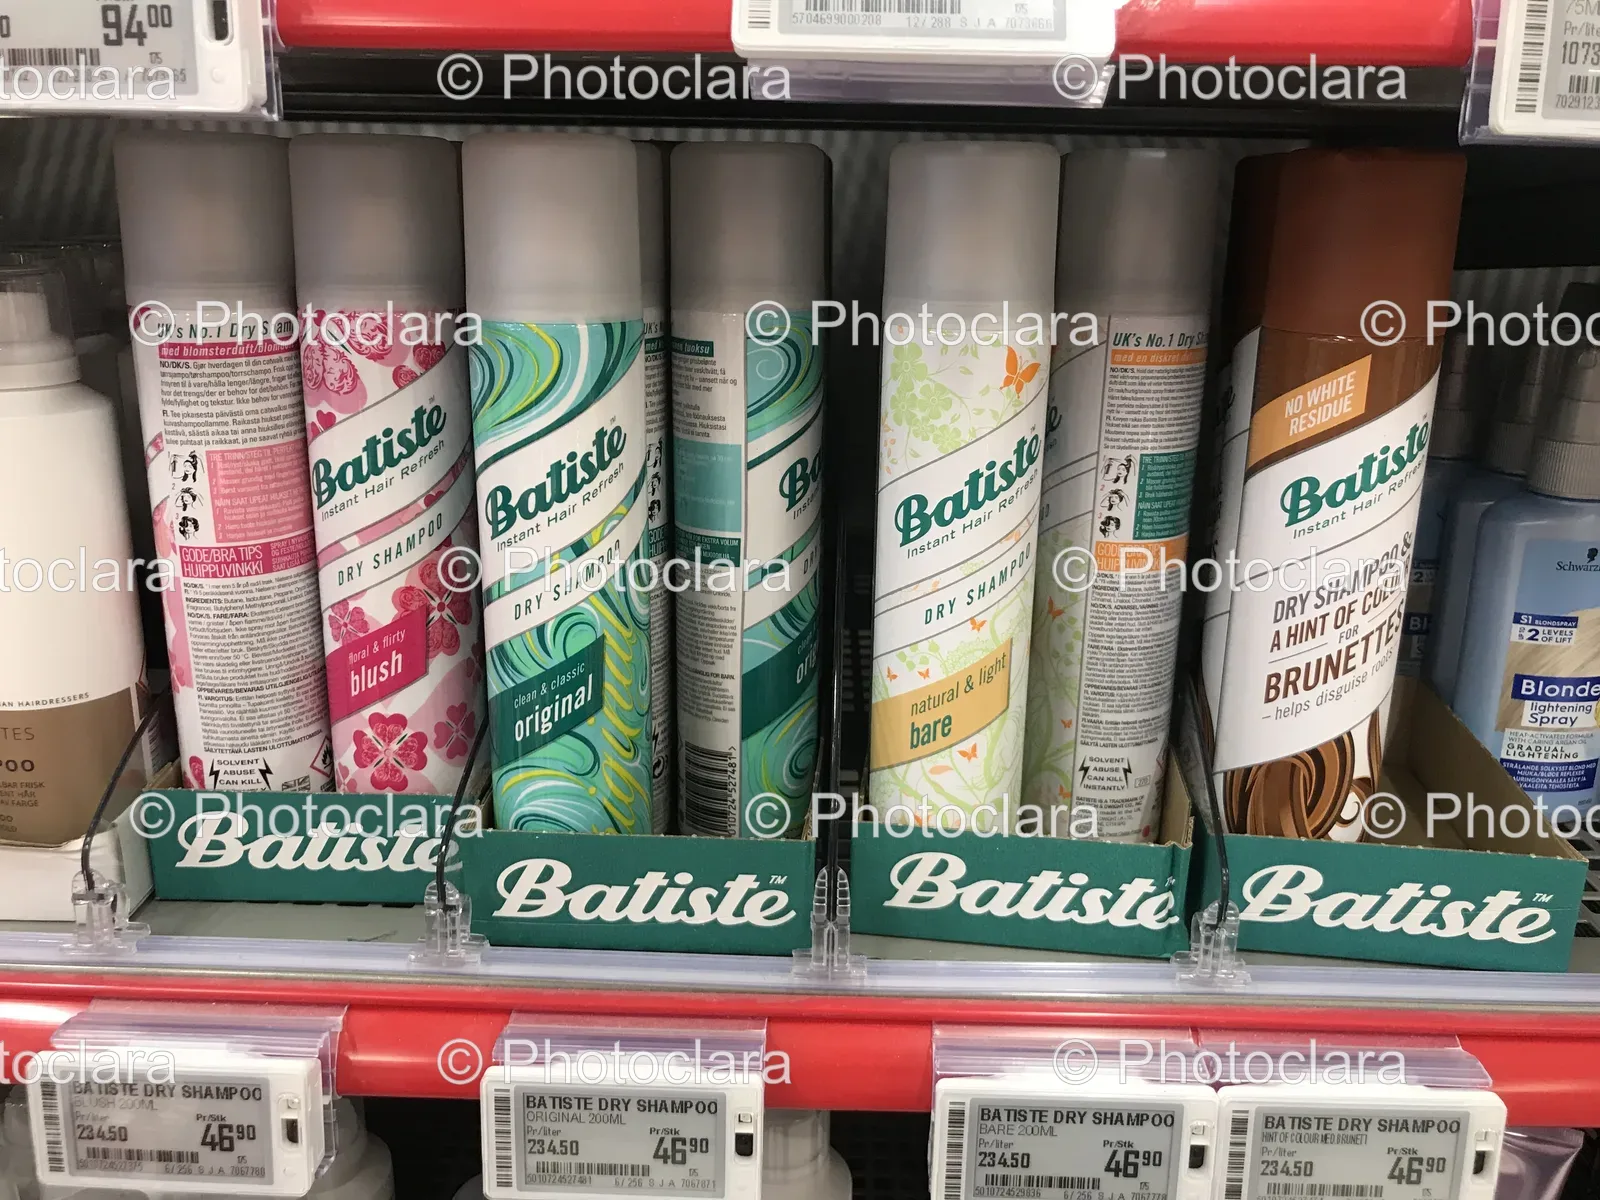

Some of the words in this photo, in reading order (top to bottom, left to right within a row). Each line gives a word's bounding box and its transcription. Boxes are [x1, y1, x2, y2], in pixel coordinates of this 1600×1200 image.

[102, 4, 147, 46] 94
[147, 4, 173, 28] 00
[1112, 331, 1142, 348] UK's
[1284, 394, 1303, 419] NO
[1306, 370, 1357, 408] WHITE
[1288, 393, 1354, 437] RESIDUE
[312, 404, 447, 510] Batiste
[321, 494, 359, 522] Instant
[365, 475, 395, 499] Hair
[400, 439, 445, 480] Refresh
[485, 425, 627, 541] Batiste
[1280, 421, 1429, 528] Batiste
[894, 433, 1042, 548] Batiste
[497, 524, 541, 552] Instant
[547, 502, 577, 528] Hair
[582, 461, 624, 507] Refresh
[907, 529, 956, 559] Instant
[962, 509, 993, 534] Hair
[998, 467, 1038, 513] Refresh
[1292, 510, 1347, 540] Instant
[1352, 491, 1384, 515] Hair
[182, 547, 238, 563] GODE/BRA
[238, 545, 263, 561] TIPS
[338, 561, 363, 586] DRY
[373, 512, 443, 570] SHAMPOO
[183, 560, 264, 578] HUIPPUVINKKI
[1272, 590, 1310, 624] DRY
[1313, 543, 1399, 610] SHAMPOO
[1401, 531, 1413, 557] &
[514, 594, 543, 621] DRY
[553, 538, 621, 601] SHAMPOO
[924, 597, 957, 625] DRY
[966, 542, 1032, 606] SHAMPOO
[1269, 630, 1282, 653] A
[1285, 612, 1330, 649] HINT
[1333, 599, 1358, 631] OF
[1338, 624, 1359, 644] FOR
[1534, 620, 1577, 628] BLONDSPRAY
[1542, 628, 1574, 637] LEVELS
[1525, 628, 1540, 641] 2
[1555, 636, 1572, 644] LIFT
[348, 646, 370, 665] floral
[372, 640, 379, 654] &
[382, 628, 406, 649] flirty
[1263, 598, 1405, 704] BRUNETTES
[350, 649, 403, 698] blush
[514, 690, 537, 709] clean
[540, 681, 548, 694] &
[550, 661, 585, 691] classic
[910, 681, 960, 717] natural
[963, 674, 975, 694] &
[978, 651, 1007, 686] light
[1274, 699, 1310, 721] helps
[1315, 671, 1368, 707] disguise
[1370, 648, 1394, 672] roots
[18, 692, 90, 707] HAIRDRESSERS
[514, 673, 593, 742] original
[1530, 702, 1593, 715] lightening
[1528, 712, 1579, 727] Spray
[909, 714, 953, 750] bare
[1505, 749, 1579, 760] LIGHTENING
[1507, 742, 1565, 753] GRADUAL
[217, 758, 260, 766] SOLVENT
[218, 778, 239, 786] CAN
[1083, 783, 1126, 791] INSTANTLY
[175, 811, 463, 872] Batiste
[492, 857, 797, 930] Batiste
[882, 851, 1180, 930] Batiste
[1238, 863, 1556, 945] Batiste
[73, 1081, 140, 1097] BATISTE
[144, 1084, 176, 1098] DRY
[182, 1085, 262, 1101] SHAMPOO
[74, 1097, 116, 1110] BLUSH
[119, 1098, 158, 1111] 200ML
[526, 1095, 593, 1111] BATISTE
[598, 1098, 631, 1112] DRY
[637, 1099, 718, 1114] SHAMPOO
[196, 1113, 227, 1122] Pr/Stk
[526, 1110, 586, 1124] ORIGINAL
[588, 1113, 627, 1125] 200ML
[980, 1108, 1049, 1123] BATISTE
[1053, 1110, 1087, 1124] DRY
[1092, 1112, 1175, 1127] SHAMPOO
[1264, 1116, 1333, 1131] BATISTE
[1338, 1118, 1372, 1132] DRY
[1377, 1119, 1461, 1134] SHAMPOO
[77, 1124, 128, 1142] 234.50
[201, 1123, 235, 1152] 46
[236, 1124, 257, 1141] 90
[526, 1126, 562, 1137] Pr/liter
[649, 1127, 681, 1136] Pr/Stk
[979, 1124, 1015, 1136] BARE
[1017, 1125, 1058, 1137] 200ML
[1261, 1131, 1278, 1143] HINT
[1279, 1132, 1289, 1143] OF
[1290, 1132, 1320, 1144] COLOUR
[527, 1138, 580, 1156] 234.50
[653, 1136, 687, 1165] 46
[689, 1138, 709, 1154] 90
[978, 1138, 1014, 1149] Pr/liter
[1103, 1139, 1134, 1149] Pr/Stk
[1261, 1146, 1297, 1158] Pr/liter
[1387, 1146, 1418, 1156] Pr/Stk
[978, 1151, 1031, 1168] 234.50
[1104, 1149, 1140, 1178] 46
[1142, 1151, 1162, 1167] 90
[1260, 1159, 1314, 1177] 234.50
[1387, 1156, 1423, 1185] 46
[1425, 1157, 1447, 1173] 90
